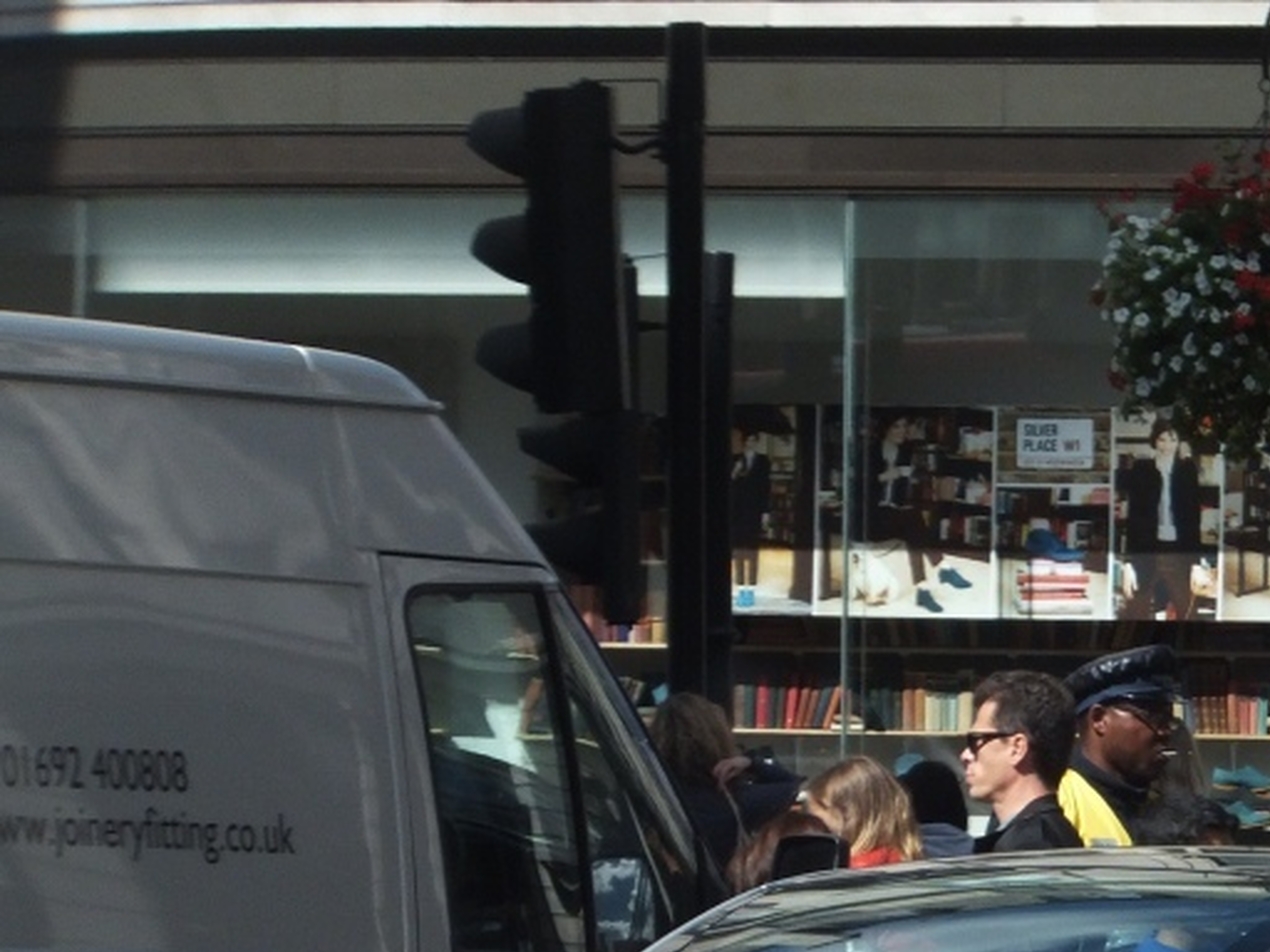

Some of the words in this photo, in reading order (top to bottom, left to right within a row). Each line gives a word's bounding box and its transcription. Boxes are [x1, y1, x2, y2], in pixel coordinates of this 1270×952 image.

[1023, 423, 1058, 436] SILVER
[1022, 439, 1058, 452] PLACE
[1, 744, 84, 789] 01692
[92, 747, 190, 793] 400808
